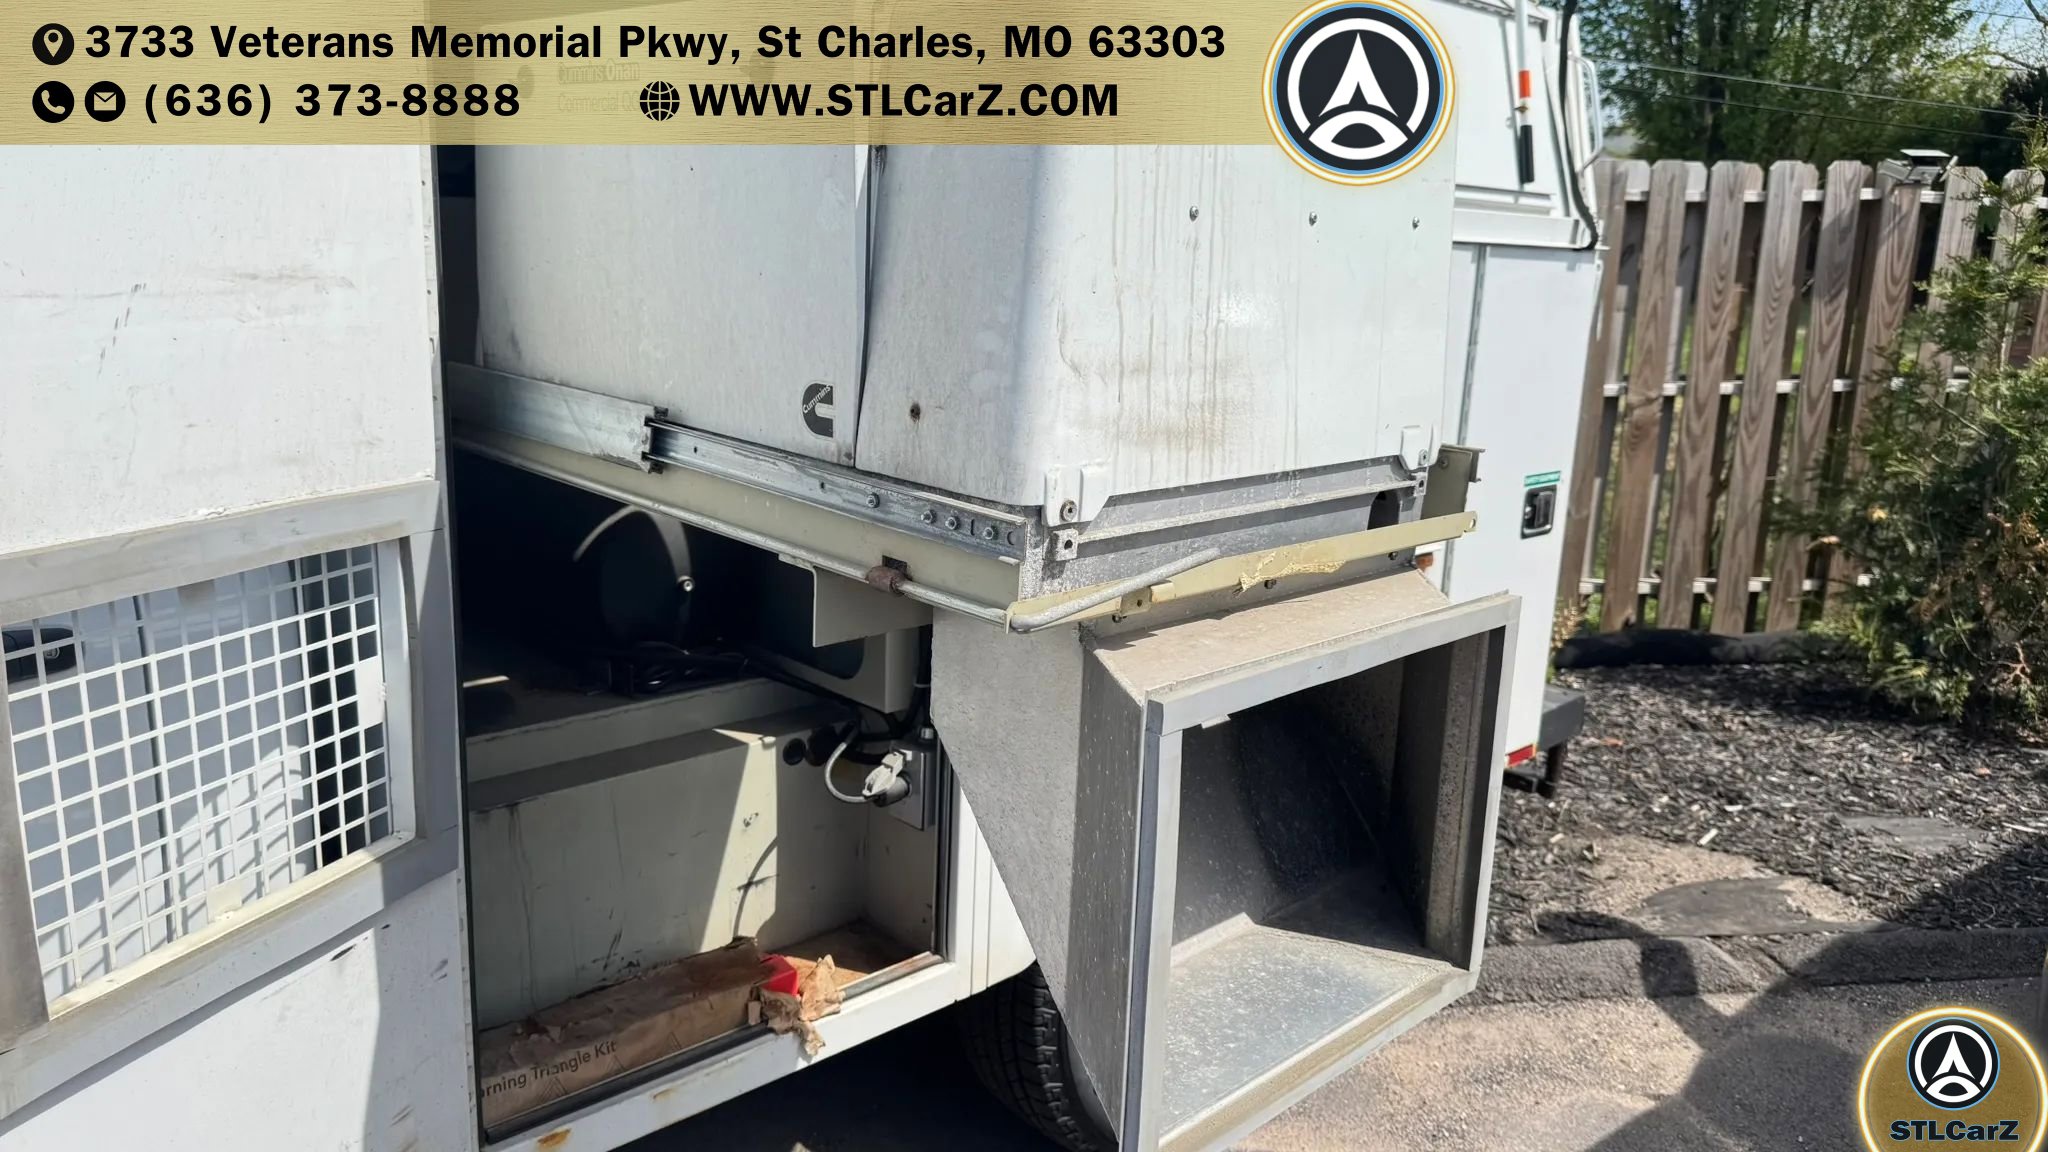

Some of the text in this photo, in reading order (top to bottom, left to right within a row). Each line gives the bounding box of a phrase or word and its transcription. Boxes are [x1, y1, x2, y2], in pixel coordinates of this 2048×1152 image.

[803, 385, 831, 413] Cummins
[530, 1050, 591, 1080] Triangle
[594, 1040, 618, 1059] Kit
